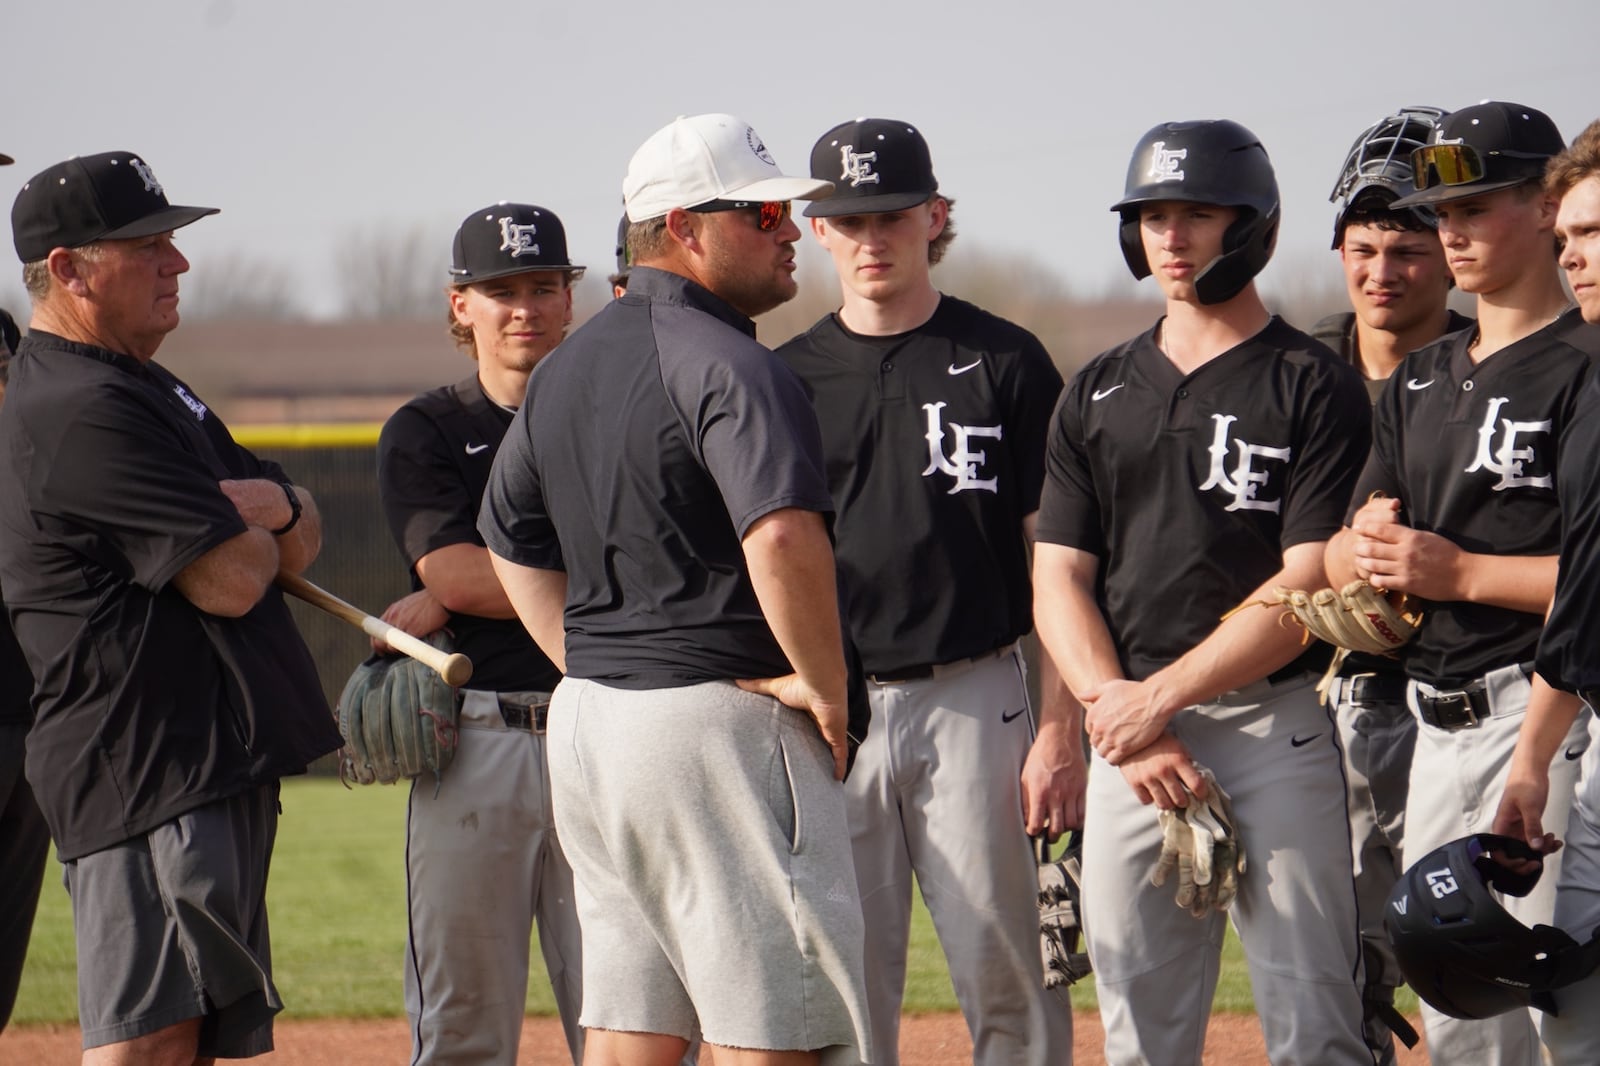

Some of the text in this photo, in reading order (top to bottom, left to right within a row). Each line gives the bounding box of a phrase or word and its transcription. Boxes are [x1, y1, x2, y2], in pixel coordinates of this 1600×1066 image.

[840, 144, 880, 188] LE
[1147, 140, 1187, 183] LE
[498, 216, 540, 258] LE
[921, 401, 1002, 495] LE
[1197, 413, 1291, 516] LE
[1463, 396, 1553, 492] LE
